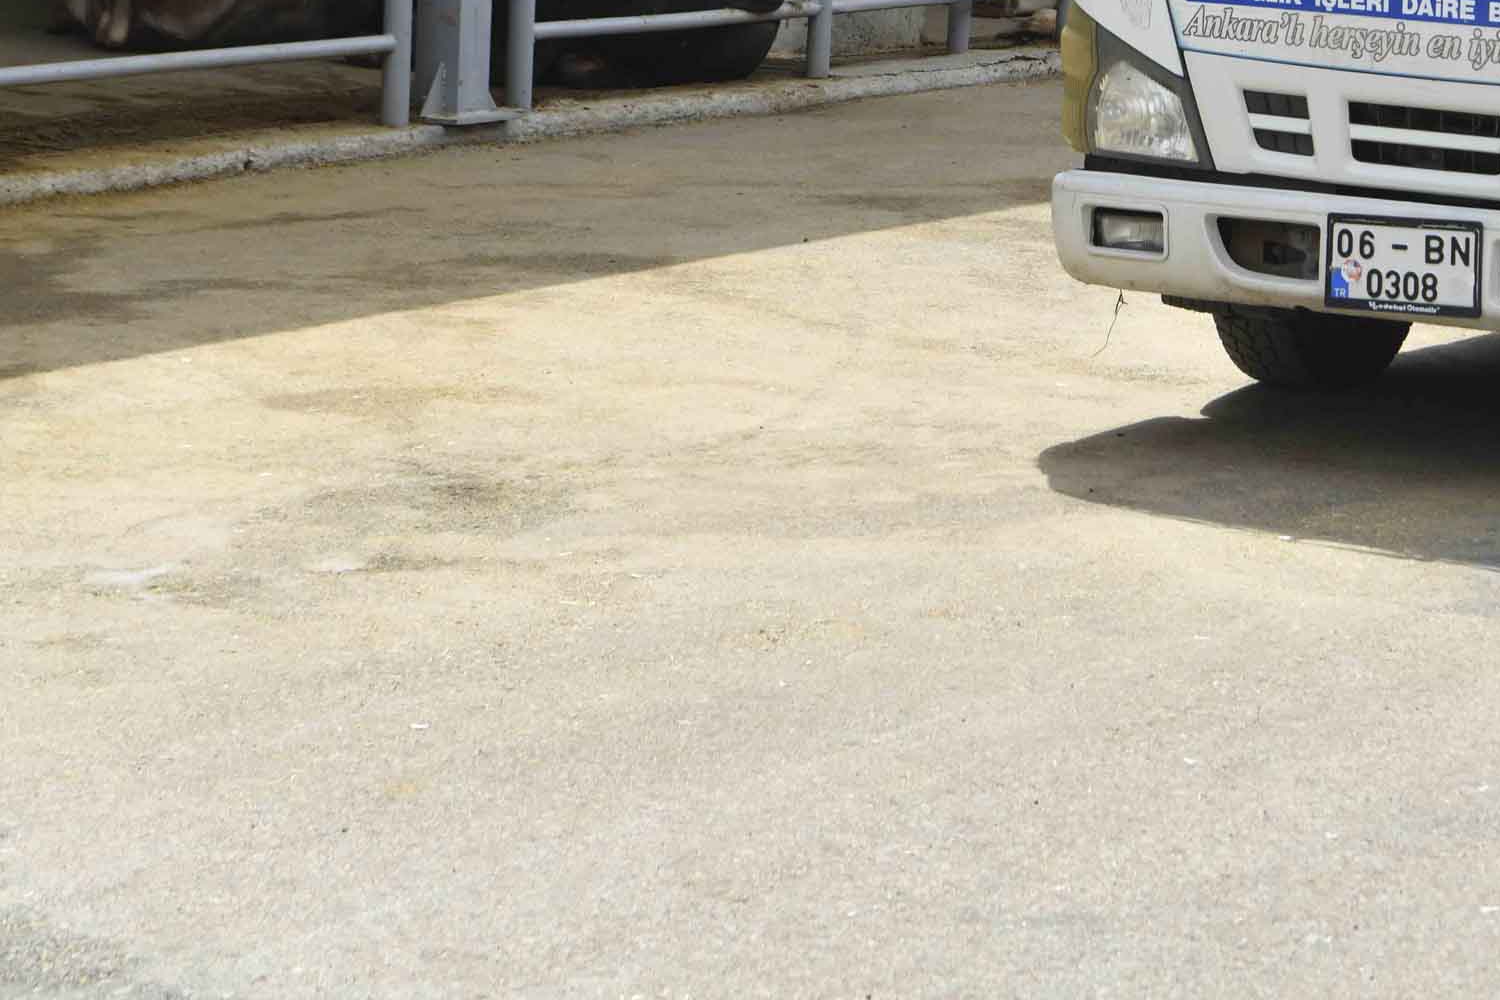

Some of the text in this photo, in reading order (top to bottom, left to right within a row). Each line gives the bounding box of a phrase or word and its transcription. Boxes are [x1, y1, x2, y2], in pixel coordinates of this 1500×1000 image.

[1183, 4, 1304, 47] Ankara'lı
[1309, 15, 1421, 62] herşeyin
[1426, 33, 1462, 60] en
[1337, 228, 1375, 260] 06
[1425, 235, 1470, 267] BN
[1334, 287, 1346, 297] TR
[1366, 268, 1438, 302] 0308
